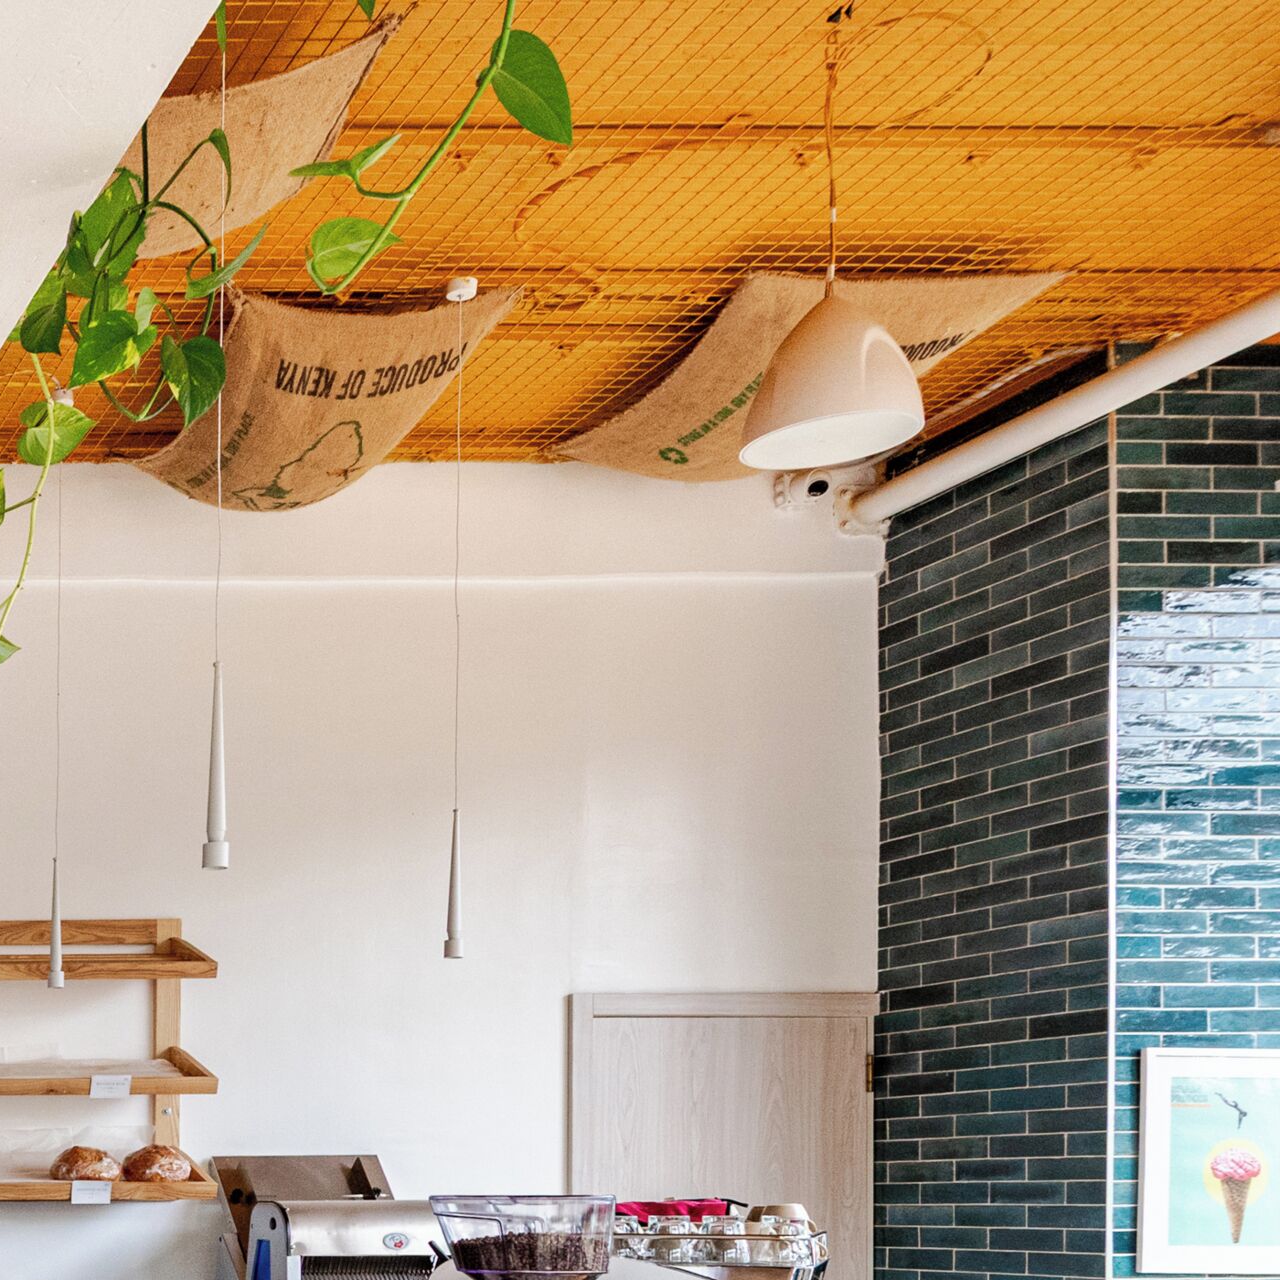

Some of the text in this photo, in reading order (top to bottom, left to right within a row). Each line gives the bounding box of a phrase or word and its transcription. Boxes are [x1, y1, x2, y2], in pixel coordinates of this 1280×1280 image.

[274, 341, 469, 400] PRODUCE OF KENYA
